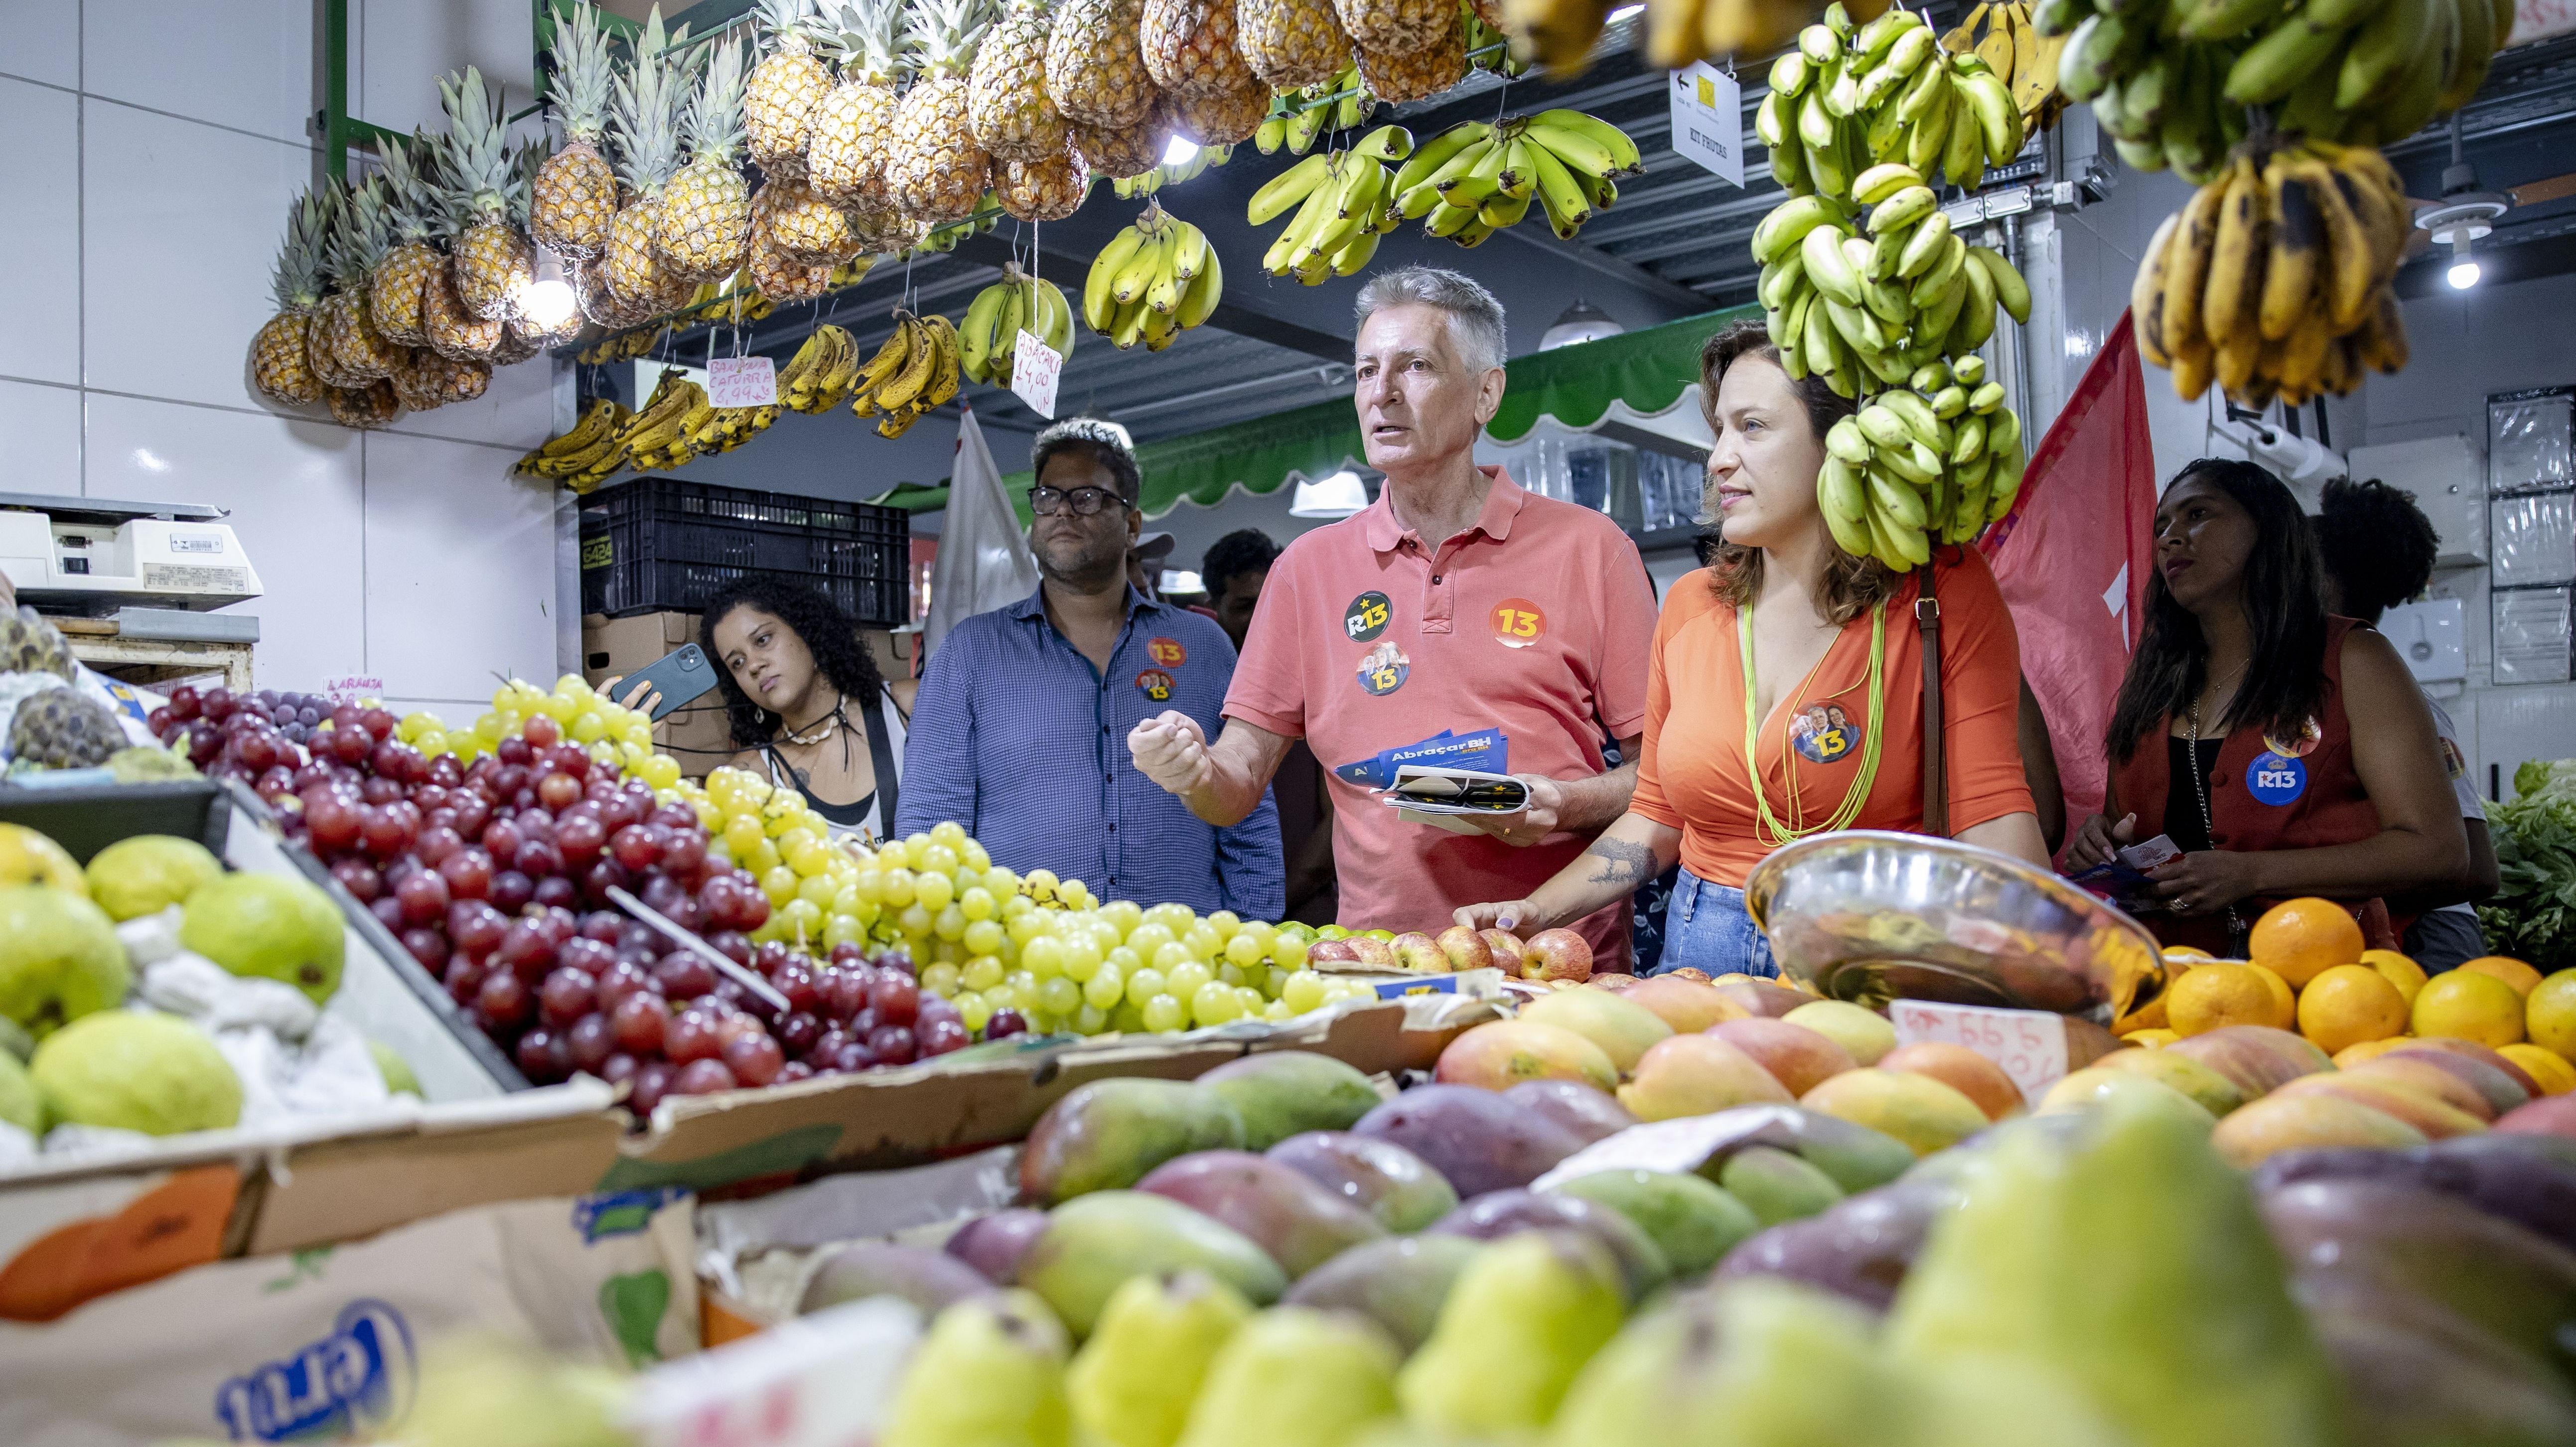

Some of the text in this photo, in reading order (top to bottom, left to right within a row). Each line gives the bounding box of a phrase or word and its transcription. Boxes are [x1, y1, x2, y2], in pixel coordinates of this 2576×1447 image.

[1690, 127, 1727, 159] KIT FRUTAS
[1018, 334, 1058, 374] ABACAXI
[709, 371, 772, 388] CATURRA
[1016, 358, 1049, 394] 14,00
[716, 386, 751, 405] 6,99
[1036, 388, 1050, 412] UN
[1347, 603, 1388, 636] R13
[1498, 608, 1539, 637] 13
[1152, 644, 1180, 661] 13
[1372, 668, 1397, 690] 13
[1149, 686, 1168, 699] 13
[1811, 729, 1846, 757] 13
[2258, 771, 2296, 788] R13
